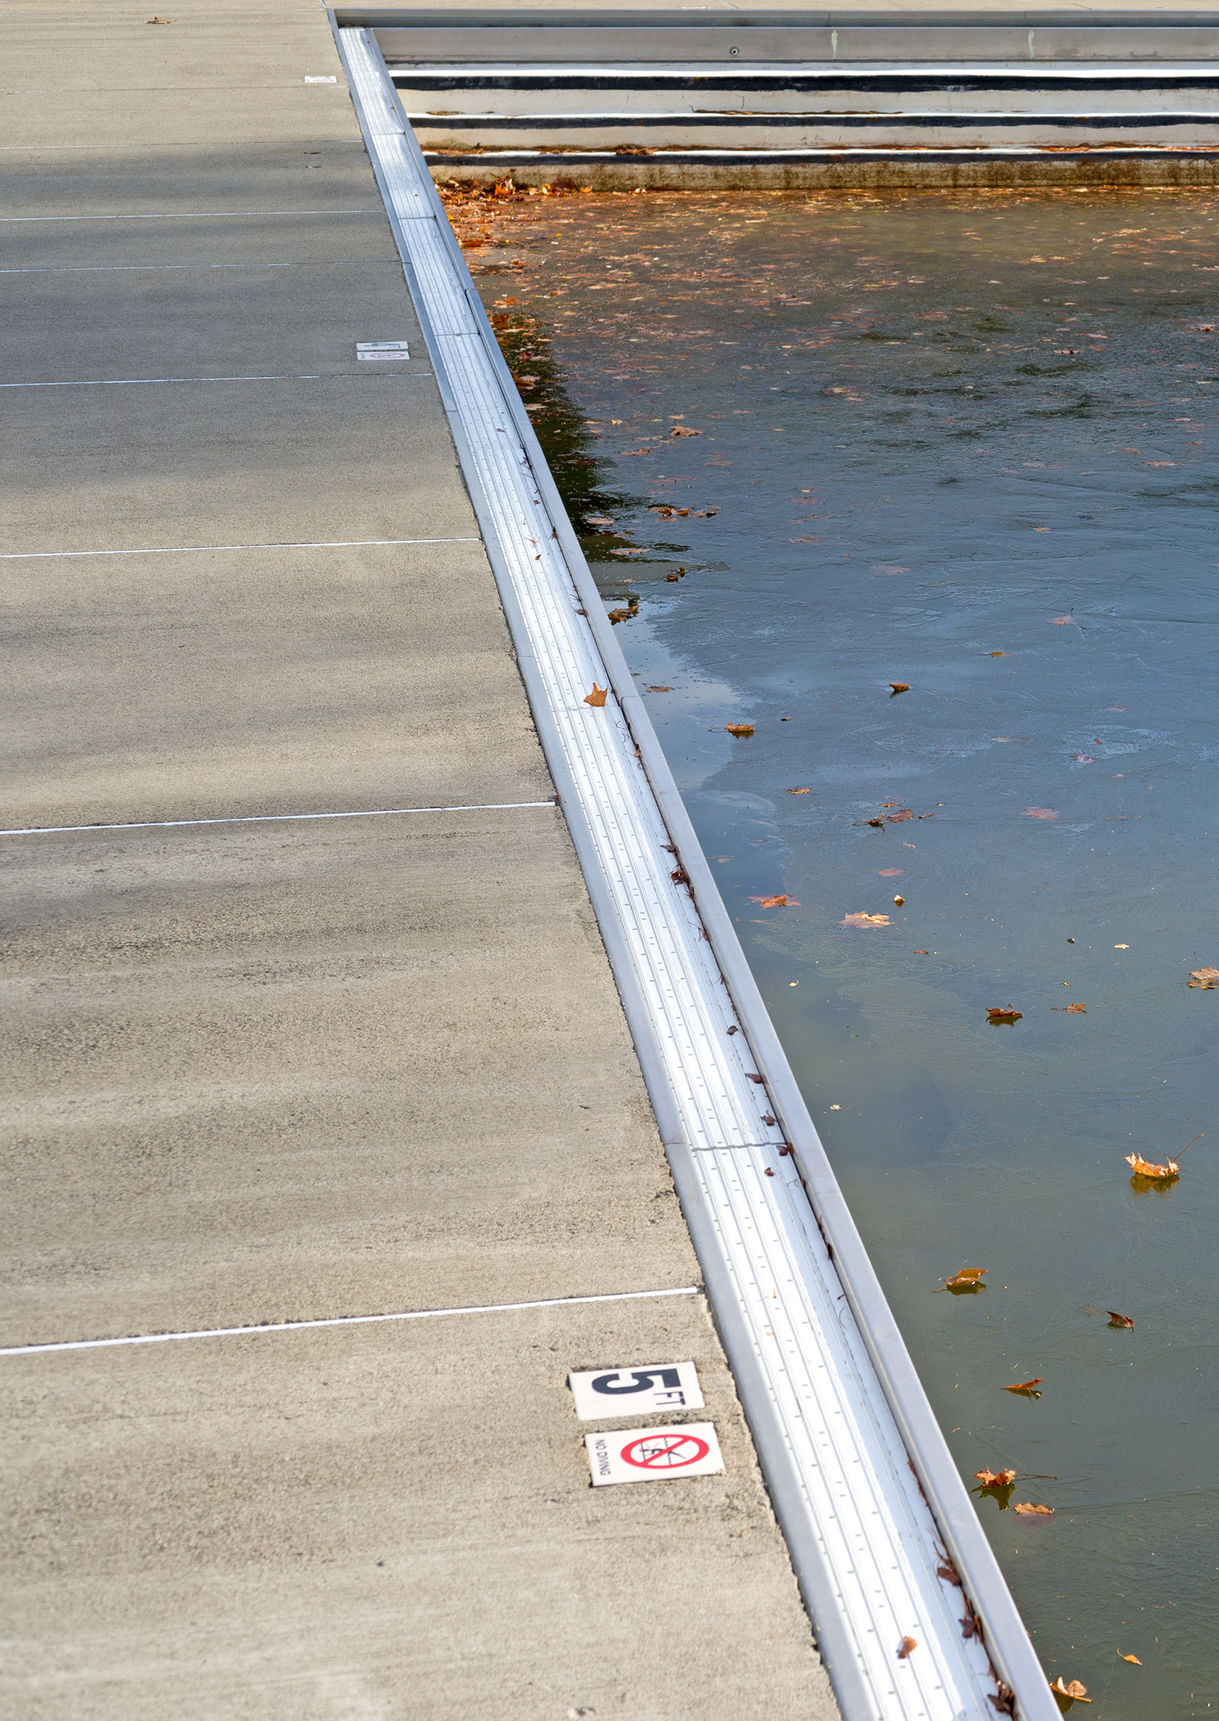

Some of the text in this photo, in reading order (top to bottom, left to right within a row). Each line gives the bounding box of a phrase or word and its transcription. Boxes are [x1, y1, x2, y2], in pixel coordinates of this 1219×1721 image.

[591, 1368, 686, 1406] 5 FT
[595, 1439, 611, 1476] NO DIVING
